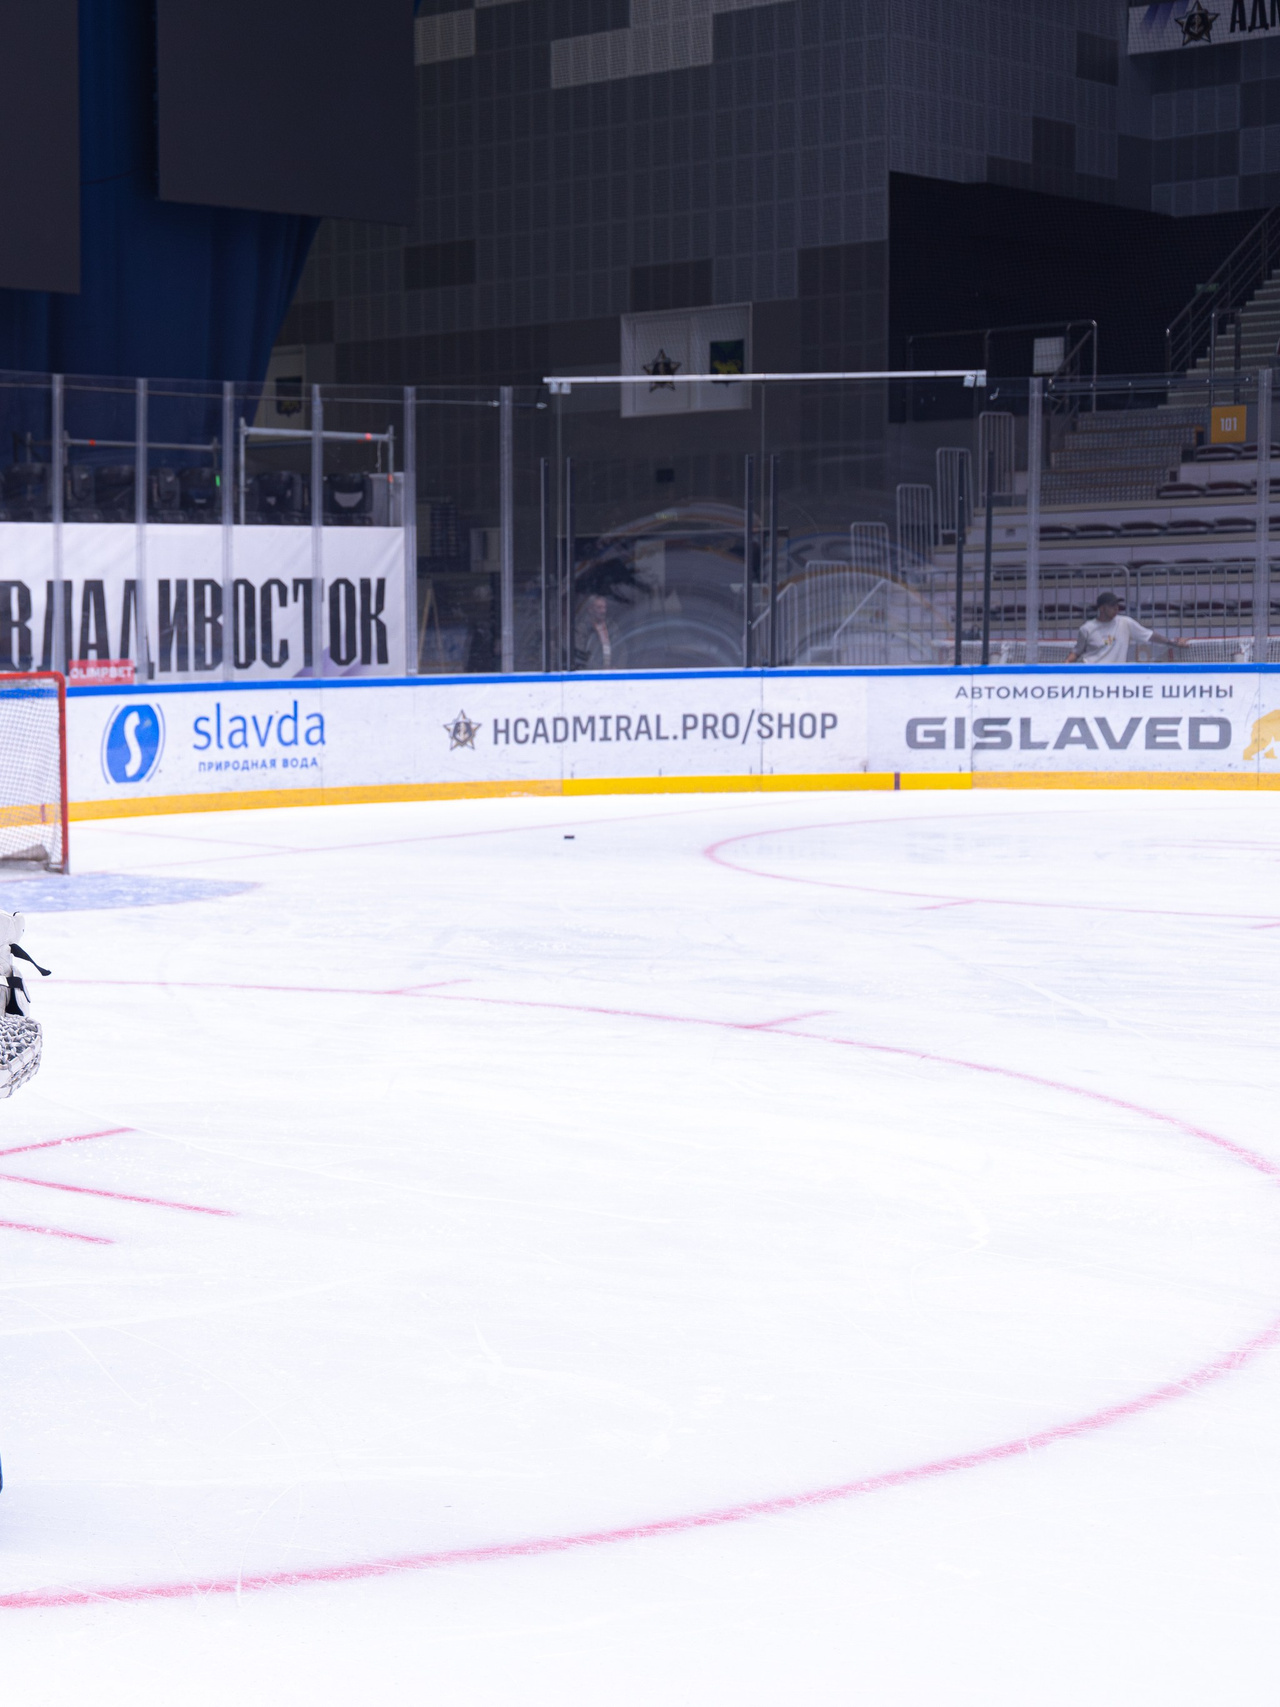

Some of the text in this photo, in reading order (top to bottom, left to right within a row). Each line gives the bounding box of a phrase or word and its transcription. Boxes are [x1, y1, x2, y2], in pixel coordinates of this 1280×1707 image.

[1220, 416, 1238, 432] 101
[70, 666, 134, 679] OLIMPBET
[955, 684, 1234, 700] АВТОМОБИЛЬНЫЕ ШИНЫ
[193, 700, 326, 751] slavda
[492, 709, 839, 746] HCADMIRAL.PRO/SHOP
[905, 717, 1233, 750] GISLAVED
[198, 757, 319, 772] ПРИРОДНАЯ ВОДА
